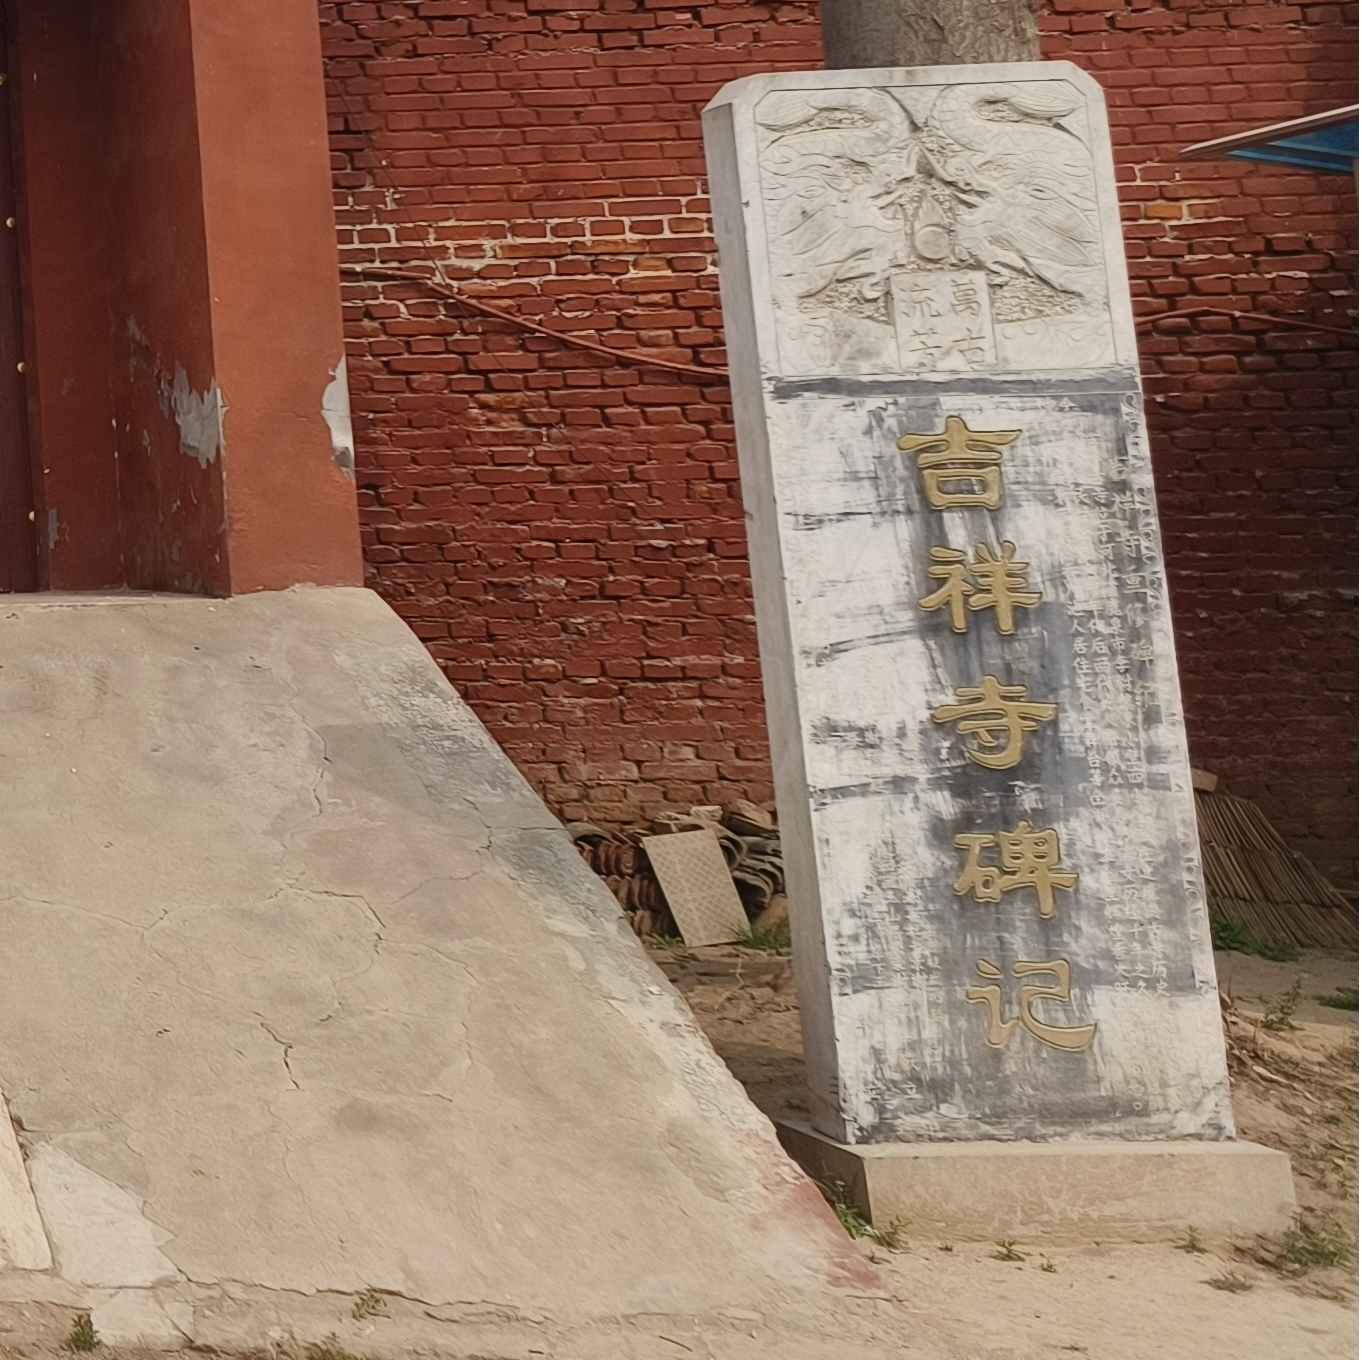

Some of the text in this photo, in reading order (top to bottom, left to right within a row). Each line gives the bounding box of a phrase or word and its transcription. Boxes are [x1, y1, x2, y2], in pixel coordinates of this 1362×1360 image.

[896, 415, 1097, 1052] 吉祥寺碑记
